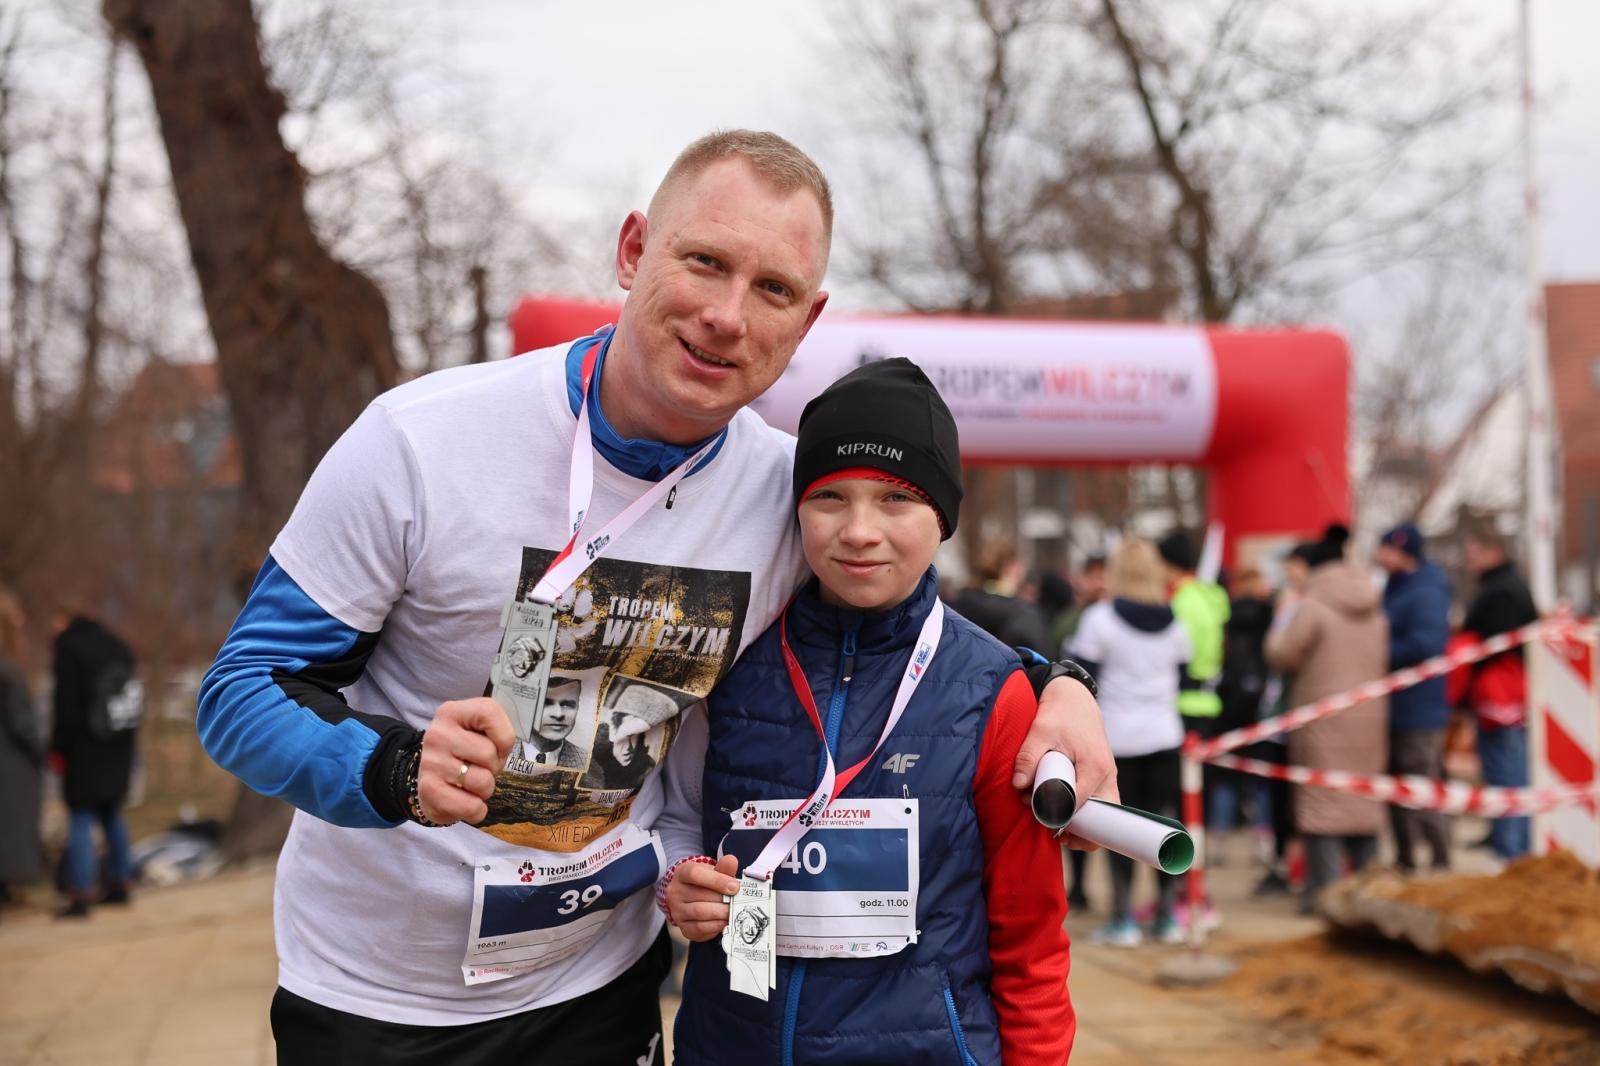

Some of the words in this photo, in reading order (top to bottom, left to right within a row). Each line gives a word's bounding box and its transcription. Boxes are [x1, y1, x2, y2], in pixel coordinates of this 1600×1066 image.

[837, 442, 903, 462] KIPRUN
[608, 595, 674, 621] TROPEM
[601, 617, 731, 657] WILCZYM
[507, 756, 535, 775] PILECKI
[881, 752, 921, 774] 4F
[760, 809, 797, 819] TROP
[548, 825, 569, 843] XIII
[538, 859, 588, 876] TROPEM
[587, 838, 623, 866] WILCZYM
[781, 841, 827, 875] 40
[557, 884, 603, 915] 39
[860, 898, 885, 908] godz.
[886, 898, 909, 908] 11.00
[477, 939, 497, 950] 1963
